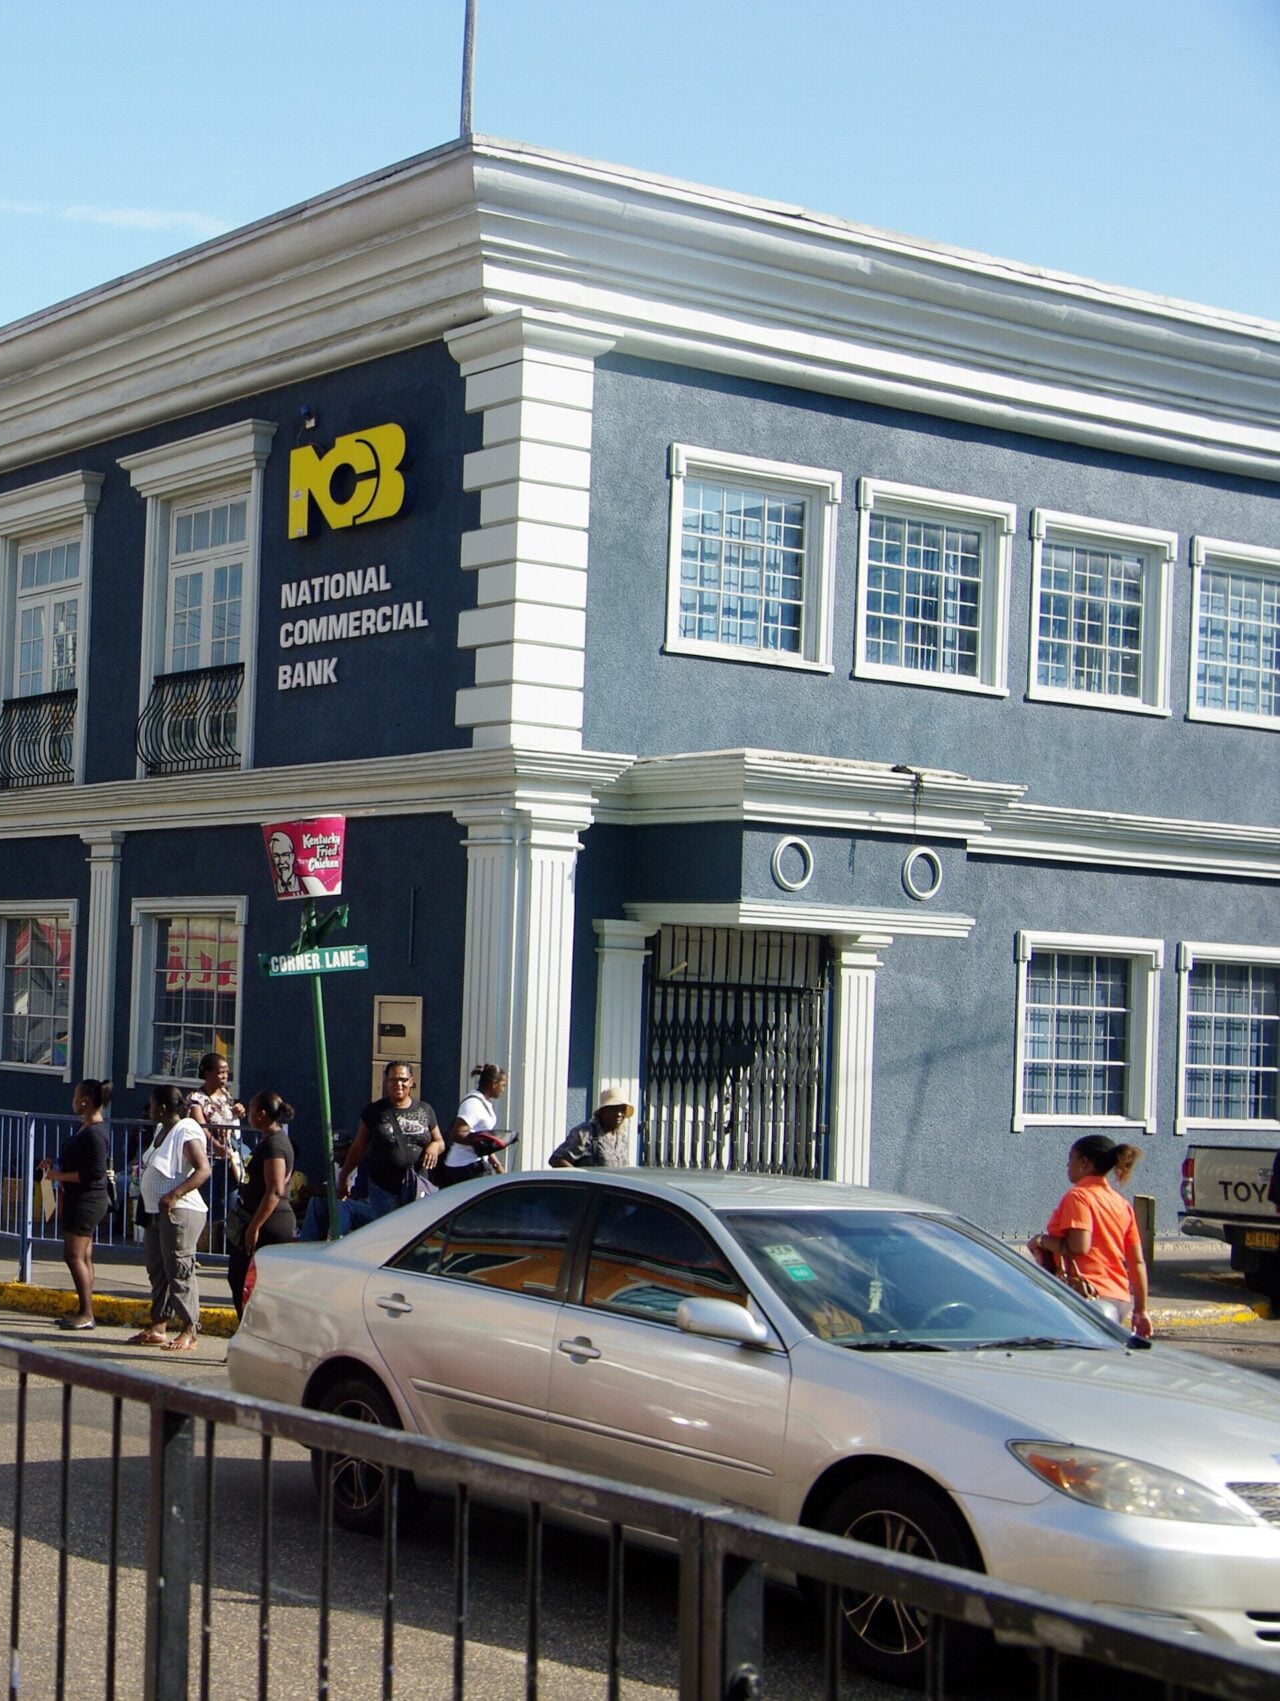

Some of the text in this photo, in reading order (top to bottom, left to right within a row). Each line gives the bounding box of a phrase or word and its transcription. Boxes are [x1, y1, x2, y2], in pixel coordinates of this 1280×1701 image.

[288, 422, 406, 540] NCB
[280, 564, 392, 609] NATIONAL
[279, 600, 429, 648] COMMERCIAL
[277, 656, 339, 691] BANK
[302, 832, 341, 849] Kentucky
[316, 844, 338, 859] Fried
[308, 857, 340, 873] Chicken
[270, 949, 357, 973] CORNER LANE
